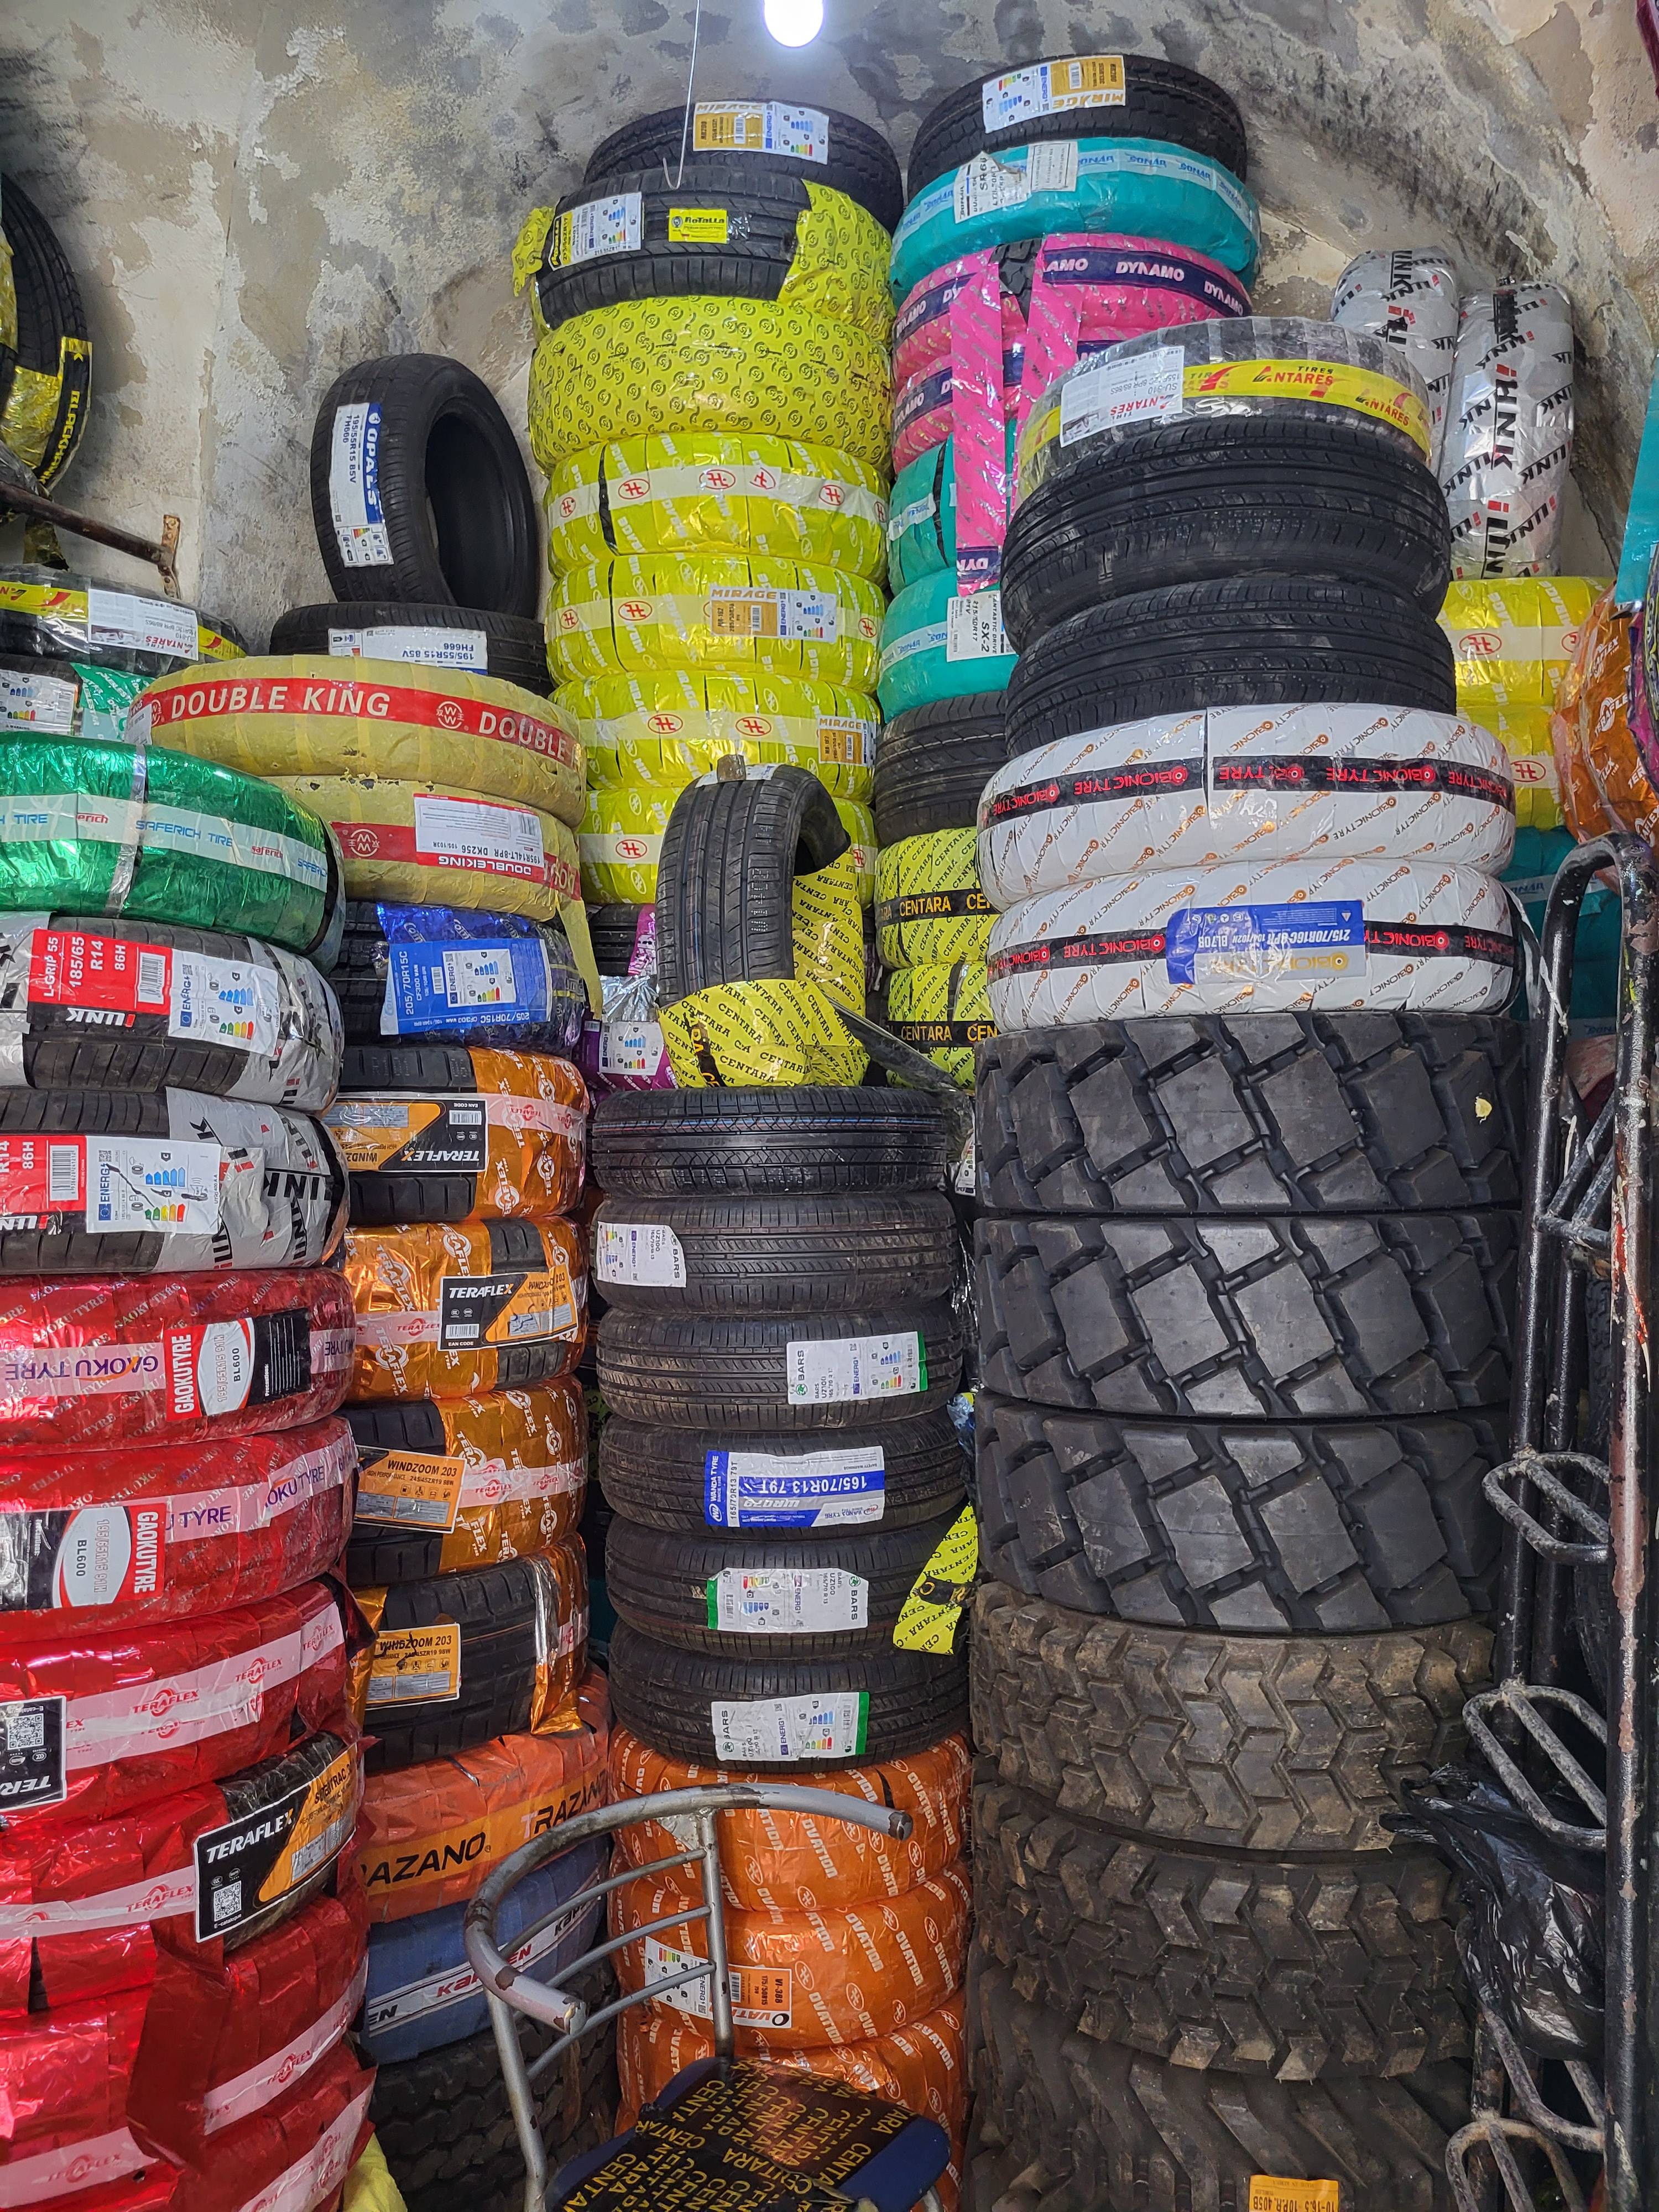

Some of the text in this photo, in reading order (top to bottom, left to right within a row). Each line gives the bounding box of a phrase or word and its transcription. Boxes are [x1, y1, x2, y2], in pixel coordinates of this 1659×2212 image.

[1115, 260, 1185, 282] DYNAMO
[1203, 280, 1244, 317] DYNAMO
[1298, 366, 1333, 374] TIRES
[364, 427, 379, 507] OPALS
[711, 589, 778, 600] MIRAGE
[443, 643, 474, 651] FH666
[981, 621, 990, 653] SX-2
[401, 649, 421, 659] 85V
[171, 687, 288, 719] DOUBLE
[304, 687, 391, 717] KING
[819, 717, 862, 730] MIRAGE
[478, 711, 567, 762] DOUBLE
[1074, 770, 1172, 795] BIONIC TYRE
[1327, 767, 1371, 782] TYRE
[14, 813, 48, 825] TIRE
[135, 820, 202, 840] SAFERICH
[208, 832, 233, 848] TIRE
[461, 844, 488, 855] DK256
[439, 855, 531, 876] DOUBLEKING
[900, 896, 952, 917] CENTARA
[1063, 940, 1151, 959] BIONIC TYRE
[1384, 932, 1436, 947] BIONIC
[44, 937, 58, 997] L-GRIP 55
[69, 937, 85, 989] 185/65
[91, 941, 103, 971] R14
[114, 945, 126, 971] 86H
[399, 951, 414, 1015] 205/70R15C
[448, 966, 456, 991] ENERG
[182, 979, 192, 1011] ENERG
[480, 1012, 530, 1024] 205/70R15C
[901, 1026, 952, 1041] CENTARA
[23, 1141, 34, 1171] 86H
[401, 1149, 480, 1162] TERAFLEX
[100, 1168, 109, 1203] ENERG
[672, 1248, 681, 1280] BARS
[450, 1284, 514, 1300] TERAFLEX
[397, 1319, 441, 1335] TERAFLEX
[5, 1355, 159, 1381] GAOKU TYRE
[172, 1334, 195, 1415] GAOKUTYRE
[797, 1350, 805, 1382] BARS
[388, 1459, 457, 1477] WINDZOOM 203
[476, 1480, 512, 1498] TERAFLEX
[710, 1474, 719, 1502] WANDA
[791, 1475, 867, 1494] 165/70R13
[729, 1478, 738, 1520] 165/70R13
[179, 1506, 232, 1527] TYRE
[76, 1539, 88, 1577] BL600
[134, 1511, 159, 1594] GAOKUTYRE
[435, 1635, 452, 1646] 203
[236, 1658, 283, 1682] TERAFLEX
[133, 1689, 199, 1714] TERAFLEX
[206, 1808, 294, 1864] TERAFLEX
[802, 1818, 838, 1879] OVATION
[360, 1832, 486, 1888] AZANO
[127, 1885, 194, 1912] TERAFLEX
[845, 1912, 884, 1973] OVATION
[1253, 2197, 1273, 2210] 405B
